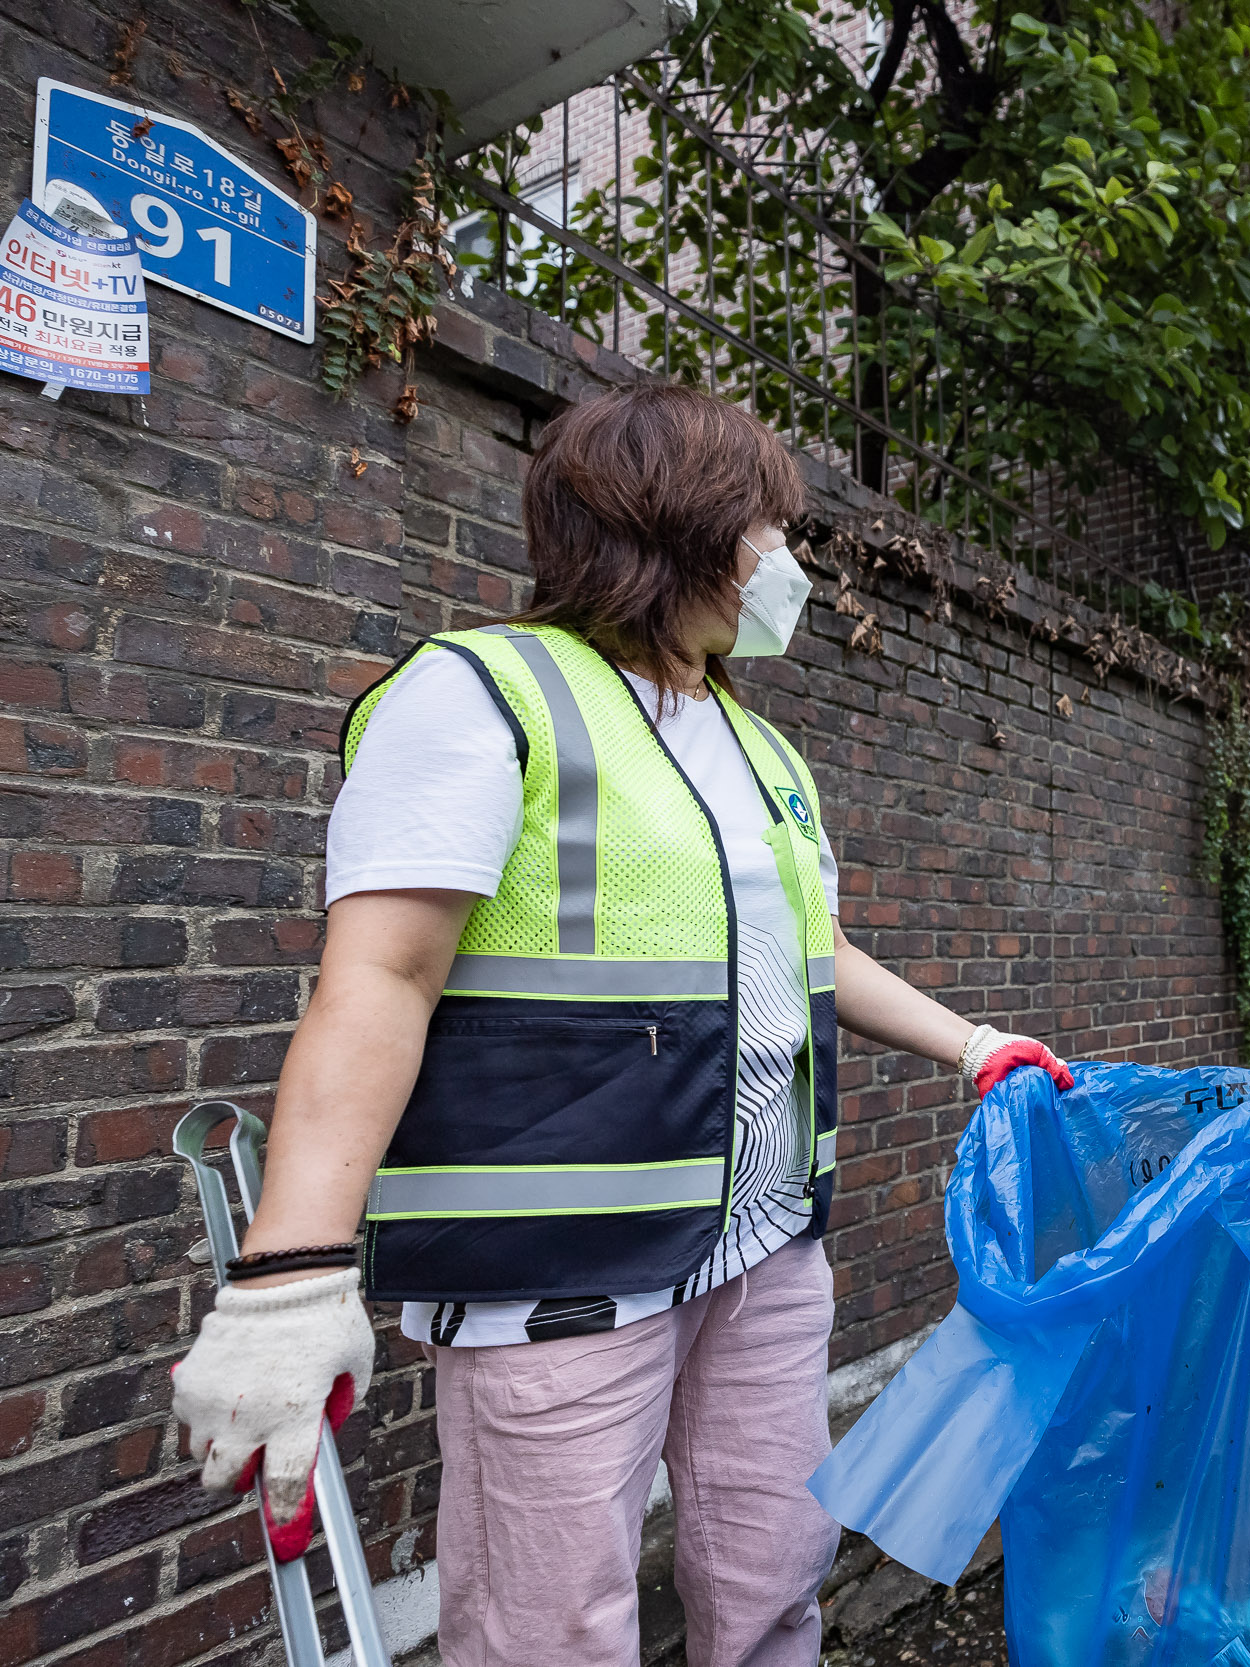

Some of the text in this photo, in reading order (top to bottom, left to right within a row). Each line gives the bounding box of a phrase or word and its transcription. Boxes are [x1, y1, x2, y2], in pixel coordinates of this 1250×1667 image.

[112, 147, 204, 201] Dongil-ro
[211, 197, 260, 228] 18-gil
[130, 193, 233, 288] 91
[0, 285, 142, 342] 46 만원지급
[34, 328, 102, 355] 최저요금
[109, 344, 138, 357] 적용
[69, 367, 139, 384] 1670-9175
